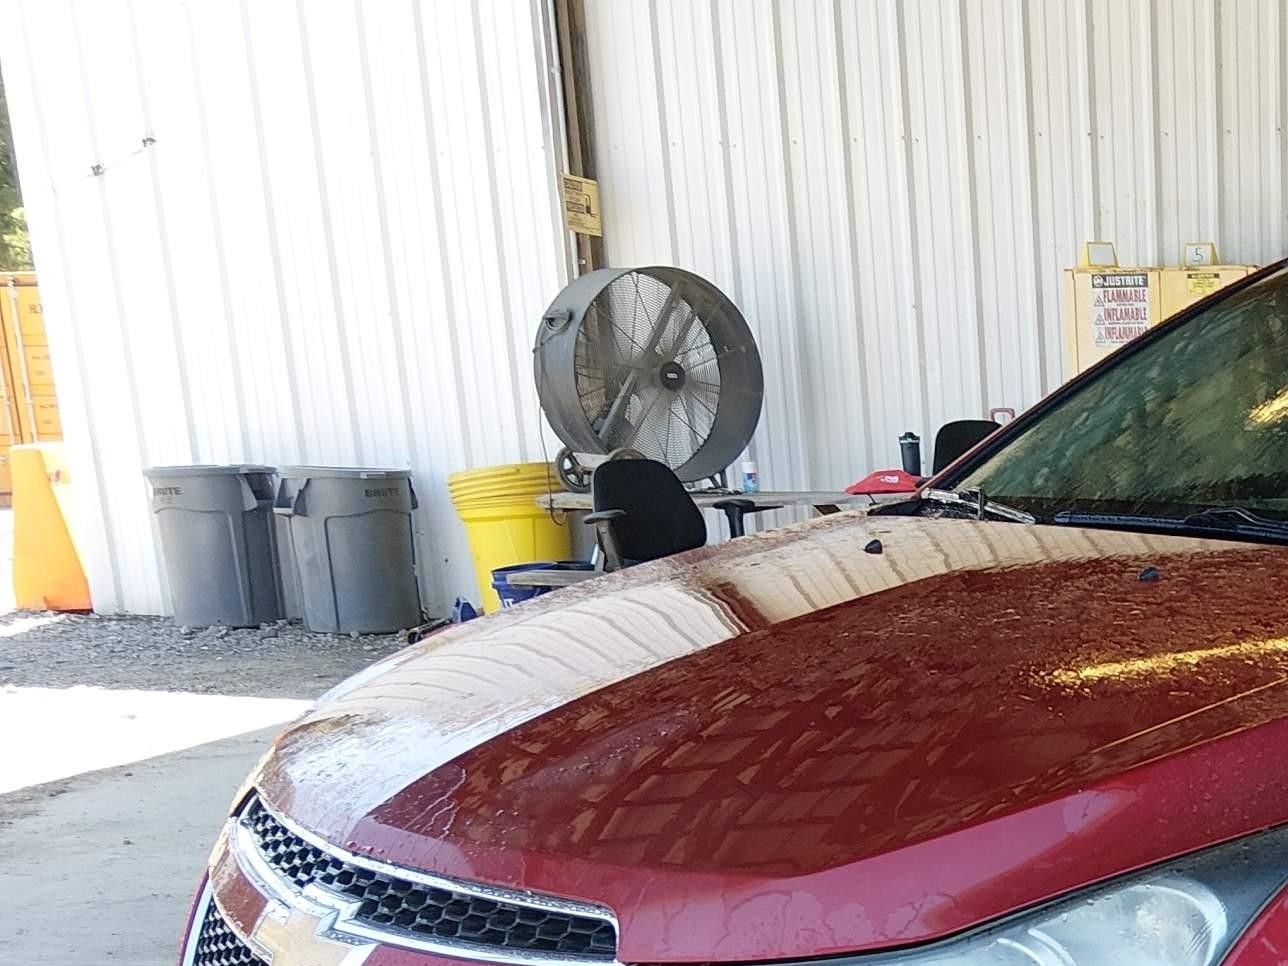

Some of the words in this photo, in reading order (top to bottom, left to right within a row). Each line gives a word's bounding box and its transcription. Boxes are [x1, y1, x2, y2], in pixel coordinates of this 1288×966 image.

[1191, 247, 1204, 263] 5
[1103, 275, 1146, 287] JUSTRITE
[1103, 289, 1147, 303] FLAMMABLE
[1104, 307, 1147, 321] INFLAMABLE
